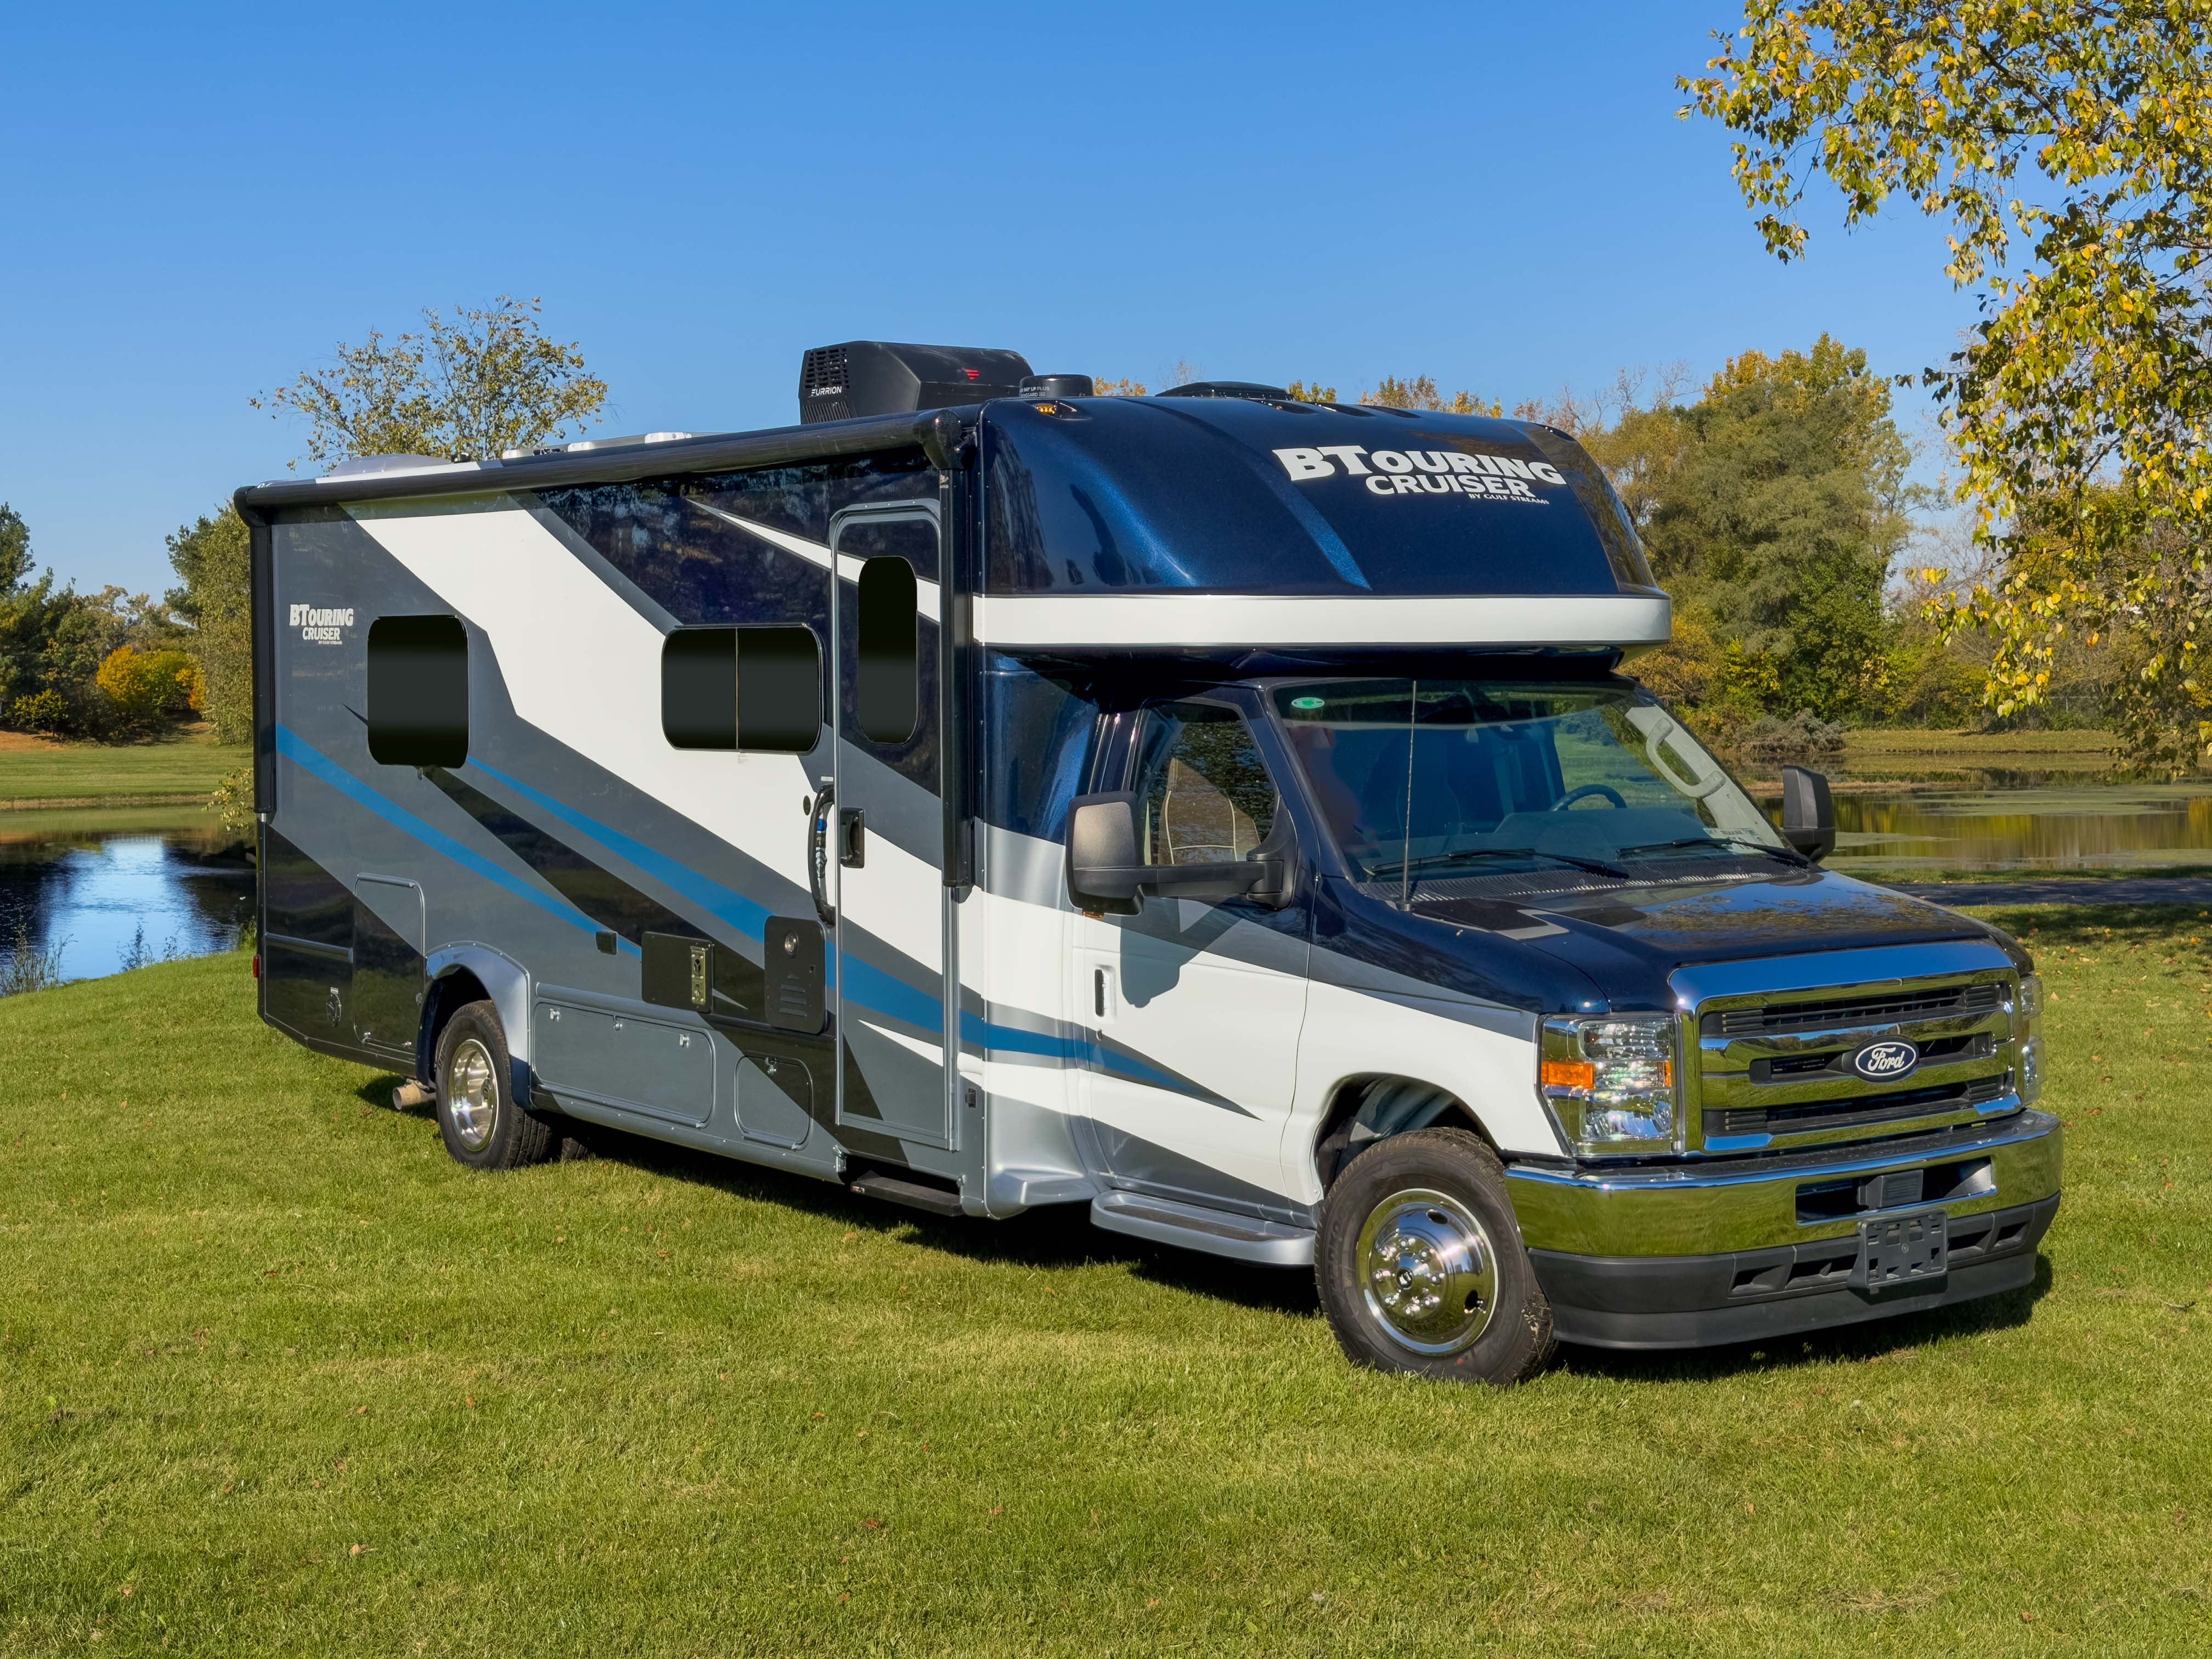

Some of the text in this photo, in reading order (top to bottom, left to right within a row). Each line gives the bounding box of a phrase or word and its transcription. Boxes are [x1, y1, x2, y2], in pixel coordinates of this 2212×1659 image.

[811, 386, 842, 396] FURRION
[1272, 445, 1567, 485] BTOURING
[1365, 475, 1536, 498] CRUISER
[289, 604, 354, 627] BTOURING
[302, 627, 341, 640] CRUISER
[1867, 1047, 1905, 1071] Ford
